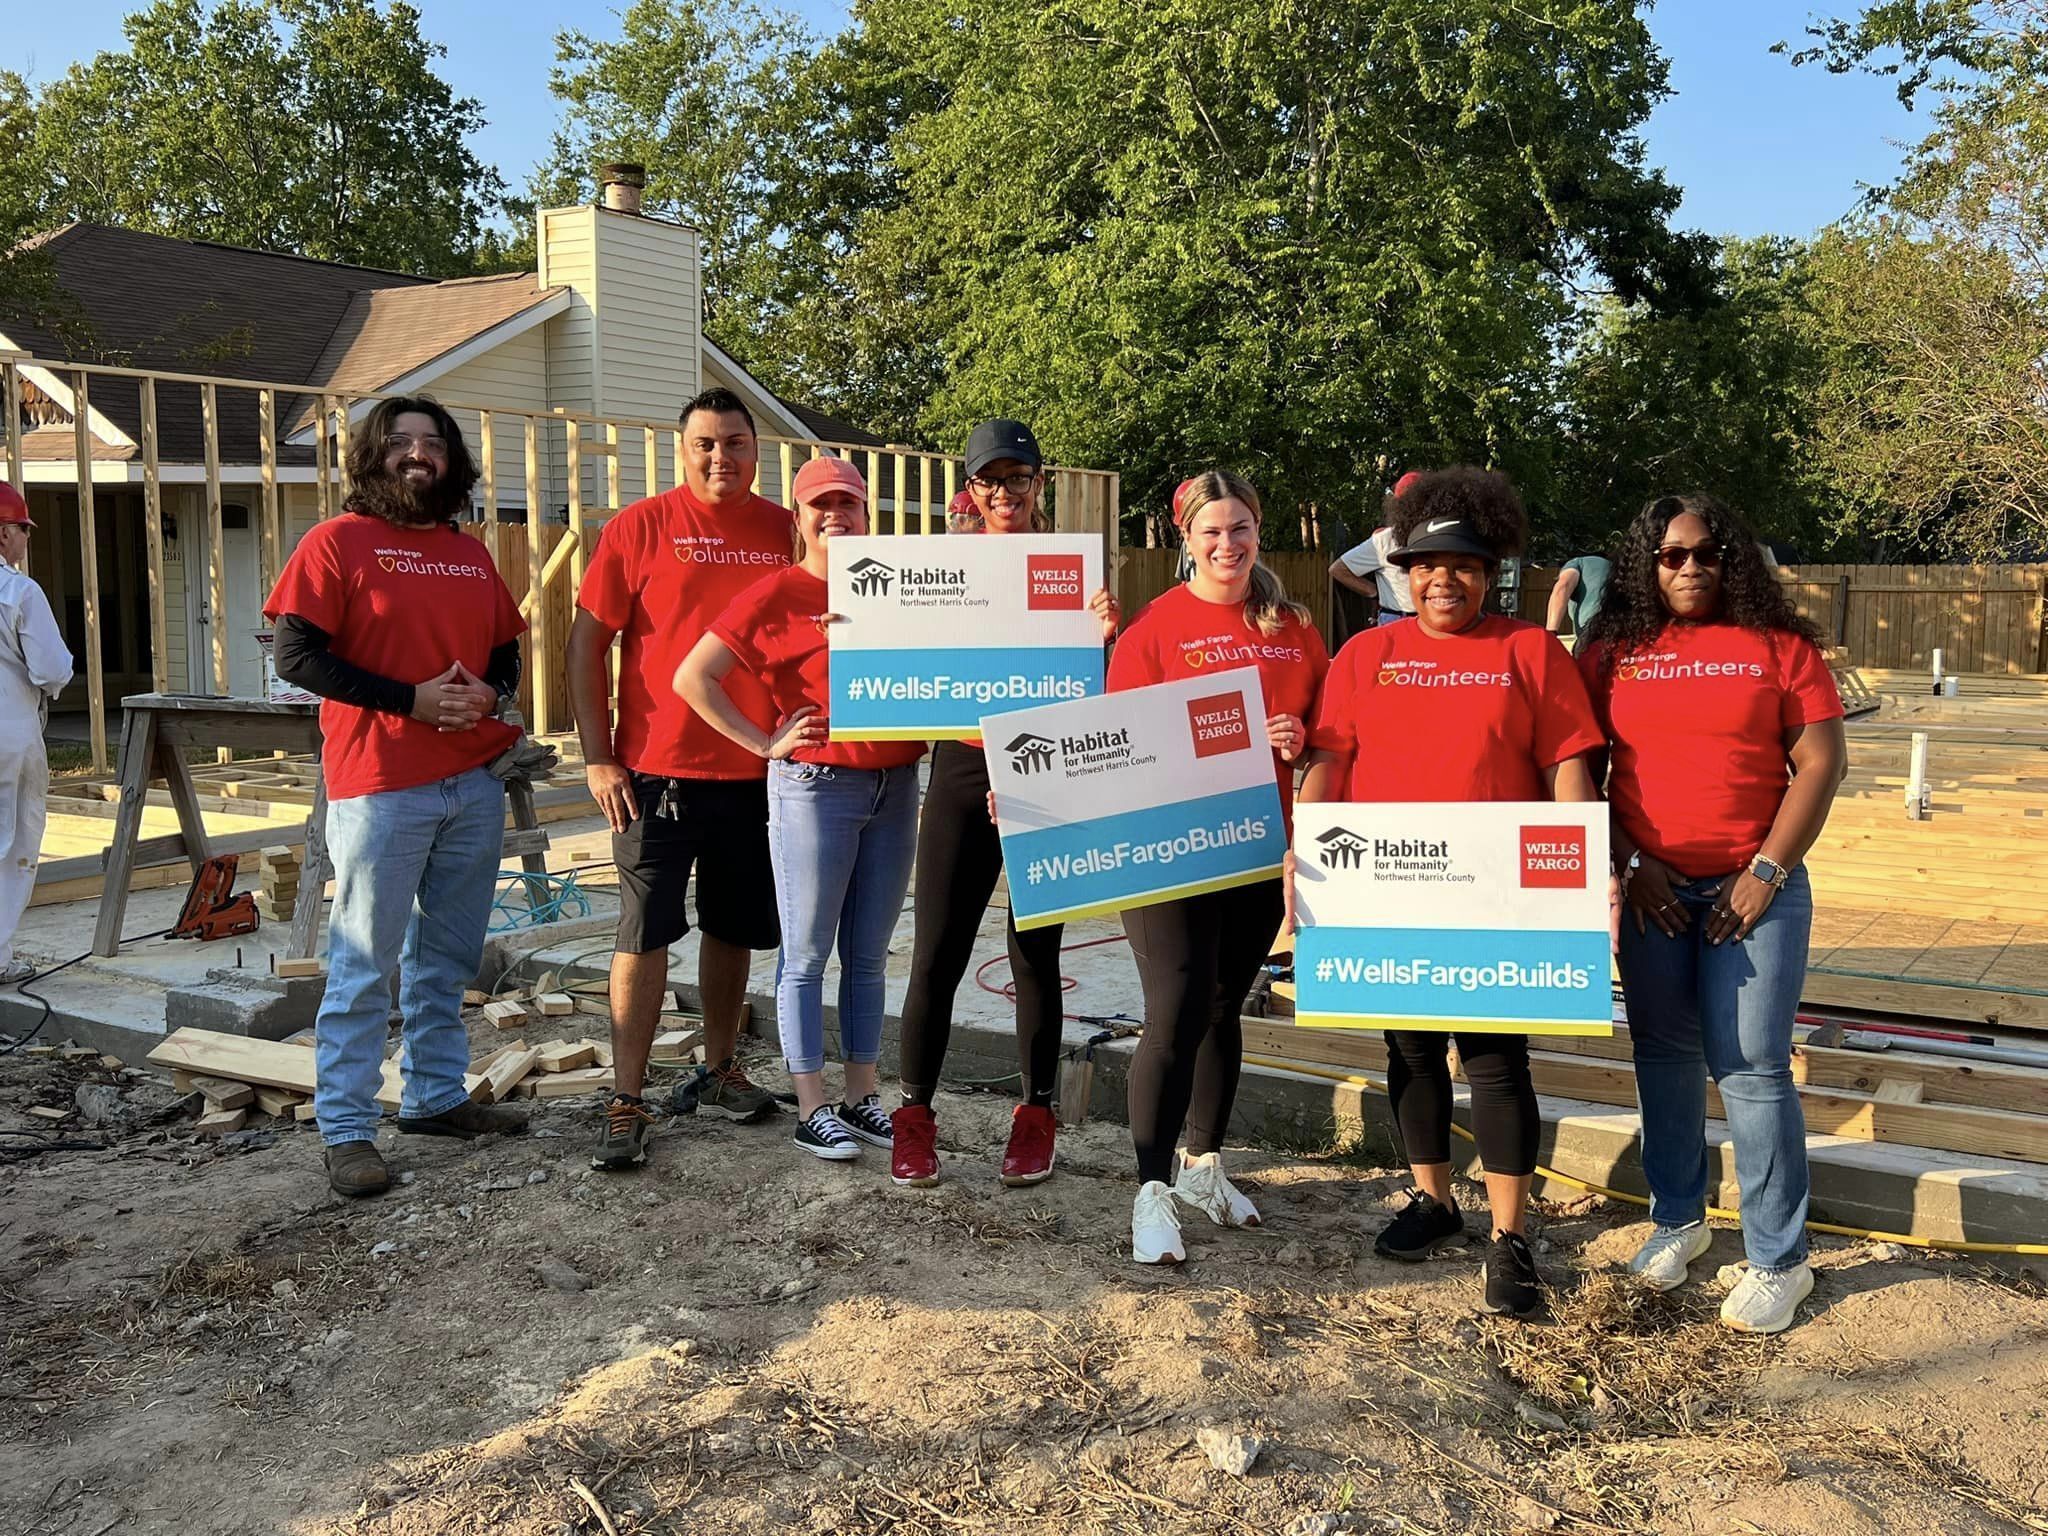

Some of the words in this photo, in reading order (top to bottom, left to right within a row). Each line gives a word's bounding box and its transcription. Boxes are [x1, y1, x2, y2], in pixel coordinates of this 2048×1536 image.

[673, 536, 698, 545] Wells
[699, 536, 725, 546] Fargo
[374, 548, 398, 556] Wells
[398, 549, 423, 559] Fargo
[900, 568, 966, 585] Habitat
[1032, 569, 1079, 581] WELLS
[900, 586, 915, 597] for
[1032, 583, 1079, 595] FARGO
[900, 598, 938, 607] Northwest
[939, 598, 962, 607] Harris
[964, 597, 990, 608] County
[1180, 639, 1206, 651] Wells
[1206, 634, 1233, 645] Fargo
[1648, 652, 1678, 663] Fargo
[1381, 660, 1407, 670] Wells
[1408, 660, 1438, 670] Fargo
[1194, 707, 1241, 726] WELLS
[1197, 722, 1244, 741] FARGO
[1060, 727, 1130, 756] Habitat
[1064, 757, 1079, 768] for
[1065, 764, 1105, 779] Northwest
[1106, 760, 1130, 772] Harris
[1130, 755, 1157, 767] County
[1374, 839, 1449, 858] Habitat
[1525, 842, 1580, 855] WELLS
[1374, 859, 1390, 870] for
[1526, 858, 1581, 871] FARGO
[1374, 872, 1417, 882] Northwest
[1418, 872, 1445, 882] Harris
[1446, 872, 1476, 884] County
